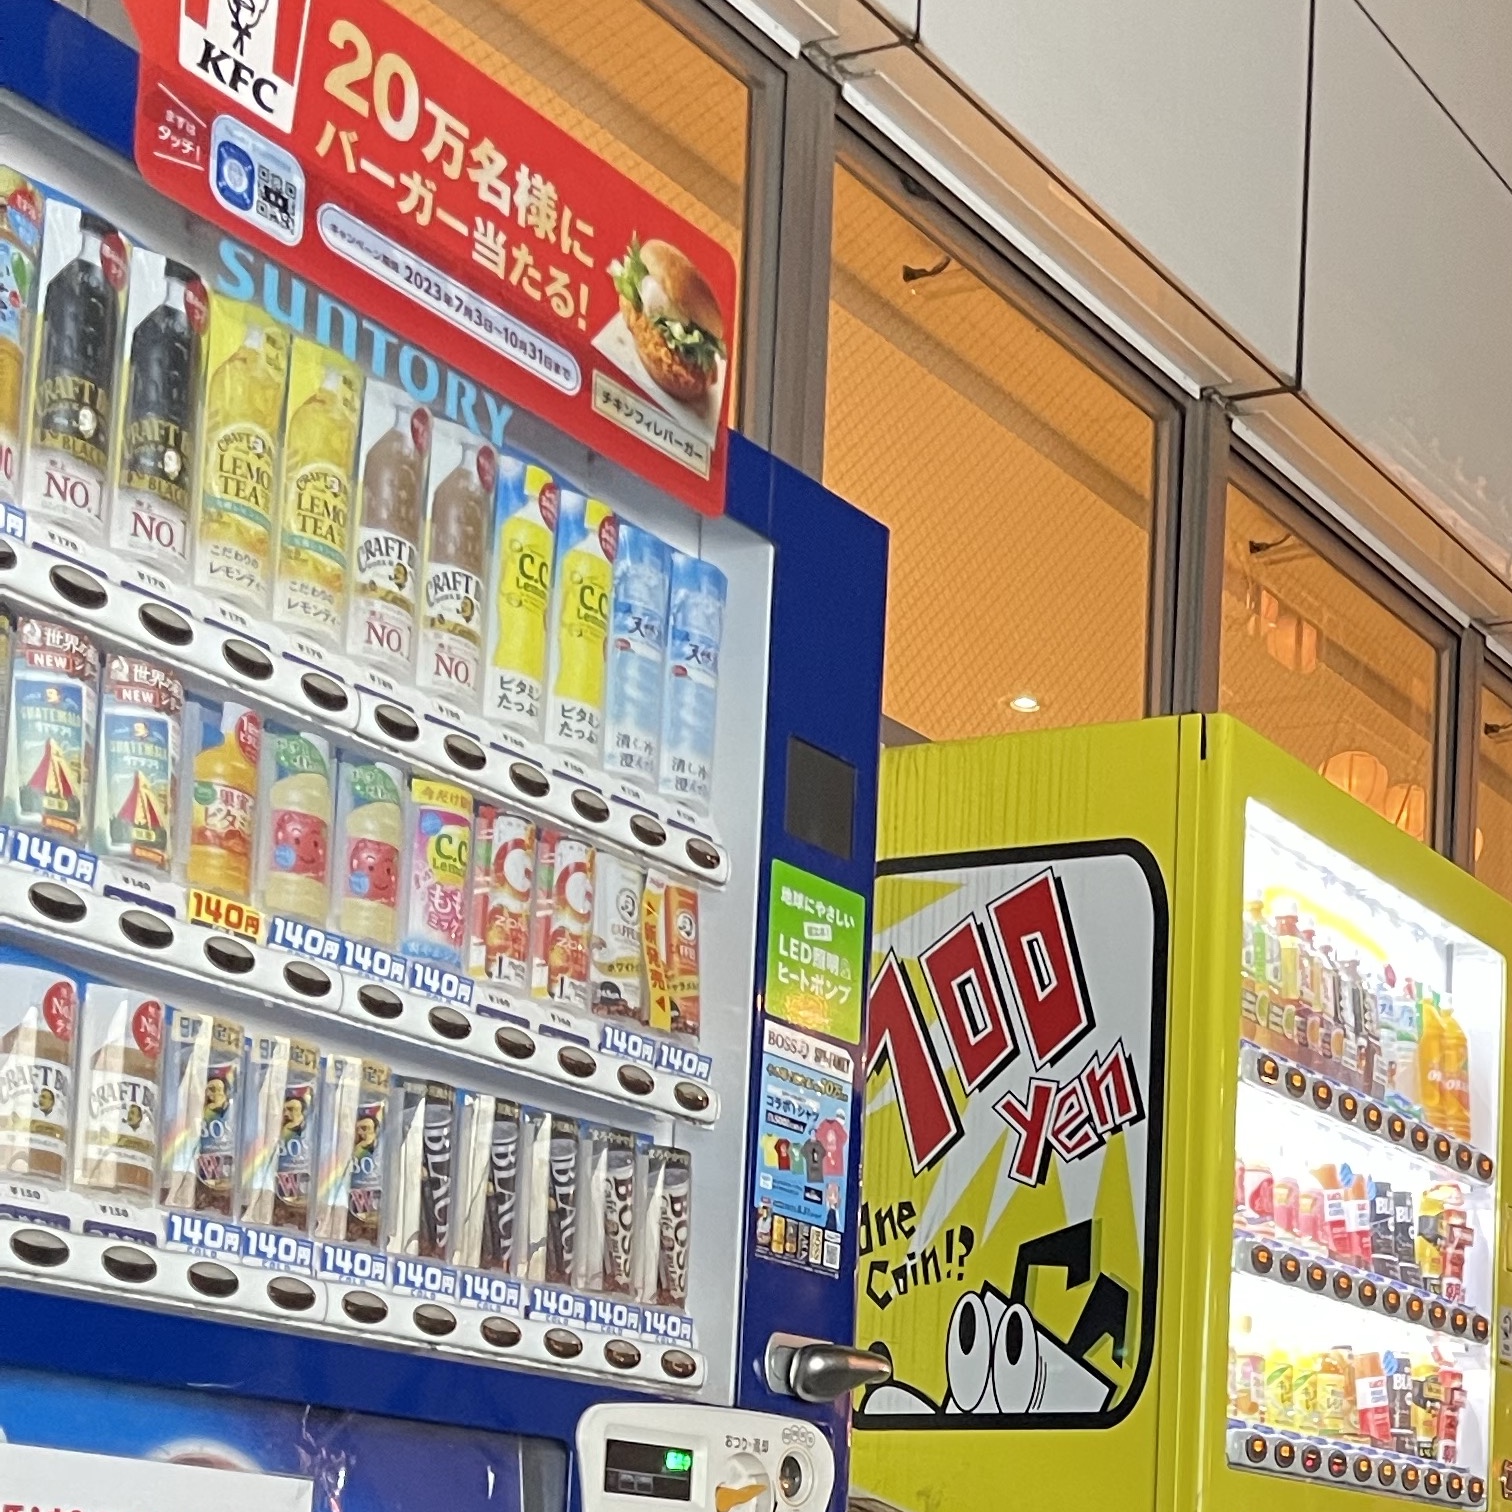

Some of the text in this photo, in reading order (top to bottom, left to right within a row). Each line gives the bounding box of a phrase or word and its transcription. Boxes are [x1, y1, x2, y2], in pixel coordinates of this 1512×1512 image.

[196, 38, 278, 114] KFC
[324, 19, 597, 269] 20万名様に
[315, 120, 592, 333] バーガー当たる!
[218, 453, 270, 491] LEMO
[221, 475, 262, 507] TEA
[296, 492, 347, 530] LEMO
[300, 518, 337, 546] TEA
[33, 654, 68, 669] NEW
[122, 689, 154, 704] NEW
[778, 961, 852, 1005] ヒートポンプ
[867, 867, 1094, 1176] 100
[992, 1037, 1145, 1188] yen
